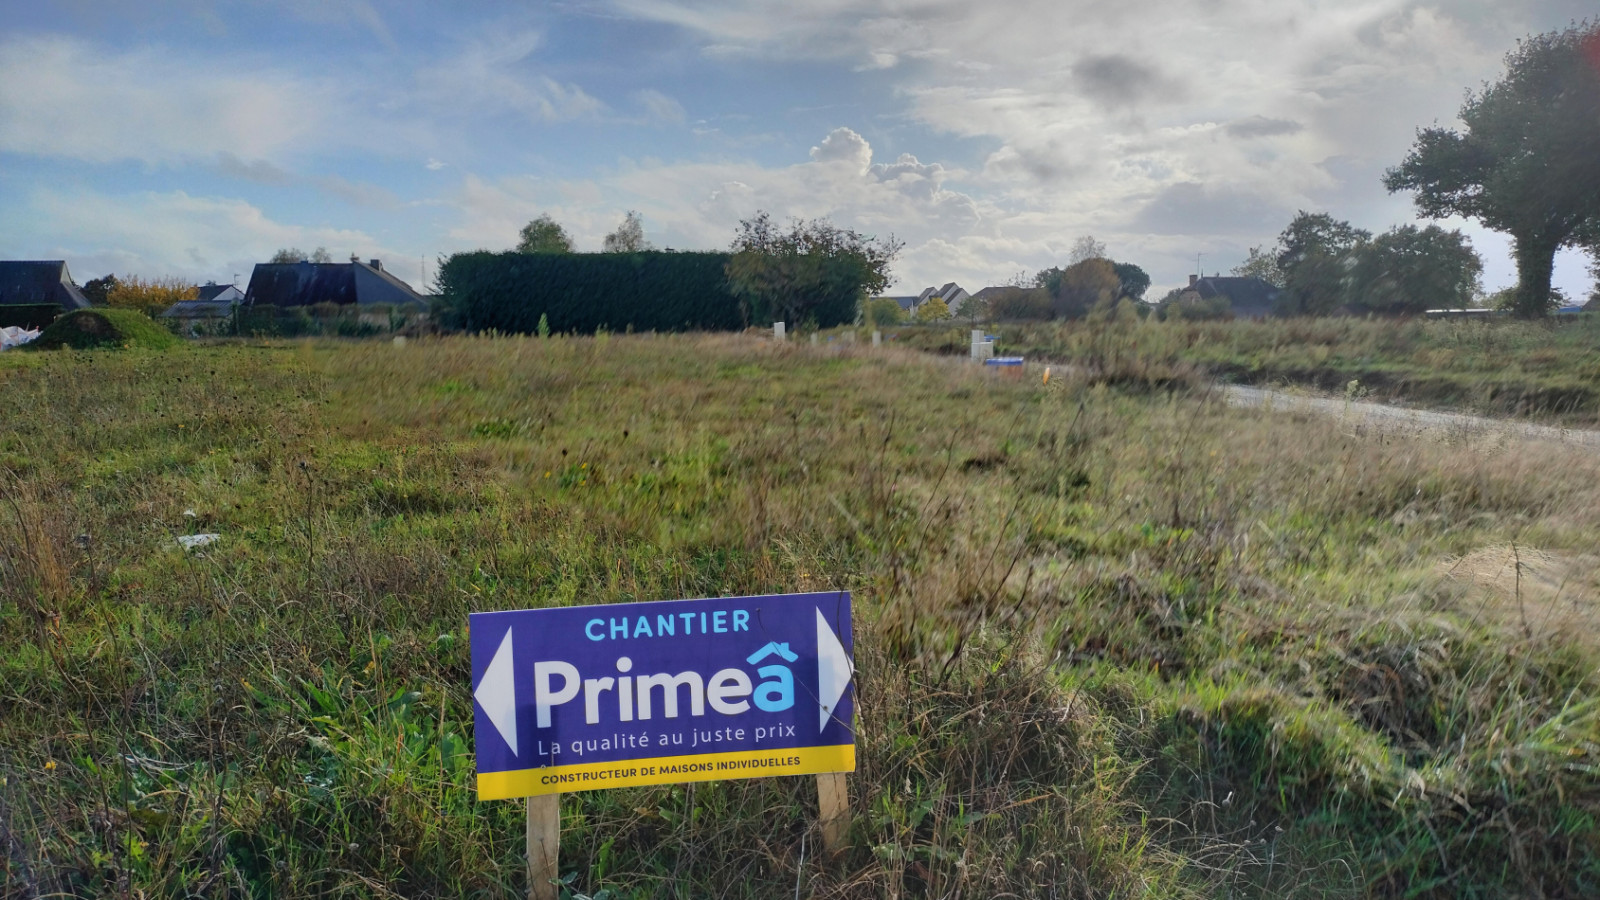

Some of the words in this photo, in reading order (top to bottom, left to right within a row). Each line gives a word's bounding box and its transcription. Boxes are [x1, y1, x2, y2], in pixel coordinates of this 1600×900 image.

[585, 609, 750, 641] CHANTIER
[534, 641, 799, 728] Primeâ
[538, 740, 561, 756] La
[572, 731, 649, 756] qualité
[659, 732, 683, 747] au
[691, 727, 745, 748] juste
[755, 723, 796, 743] prix
[541, 768, 637, 785] CONSTRUCTEUR
[640, 765, 656, 777] DE
[659, 762, 714, 775] MAISONS
[717, 756, 801, 770] INDIVIDUELLES
